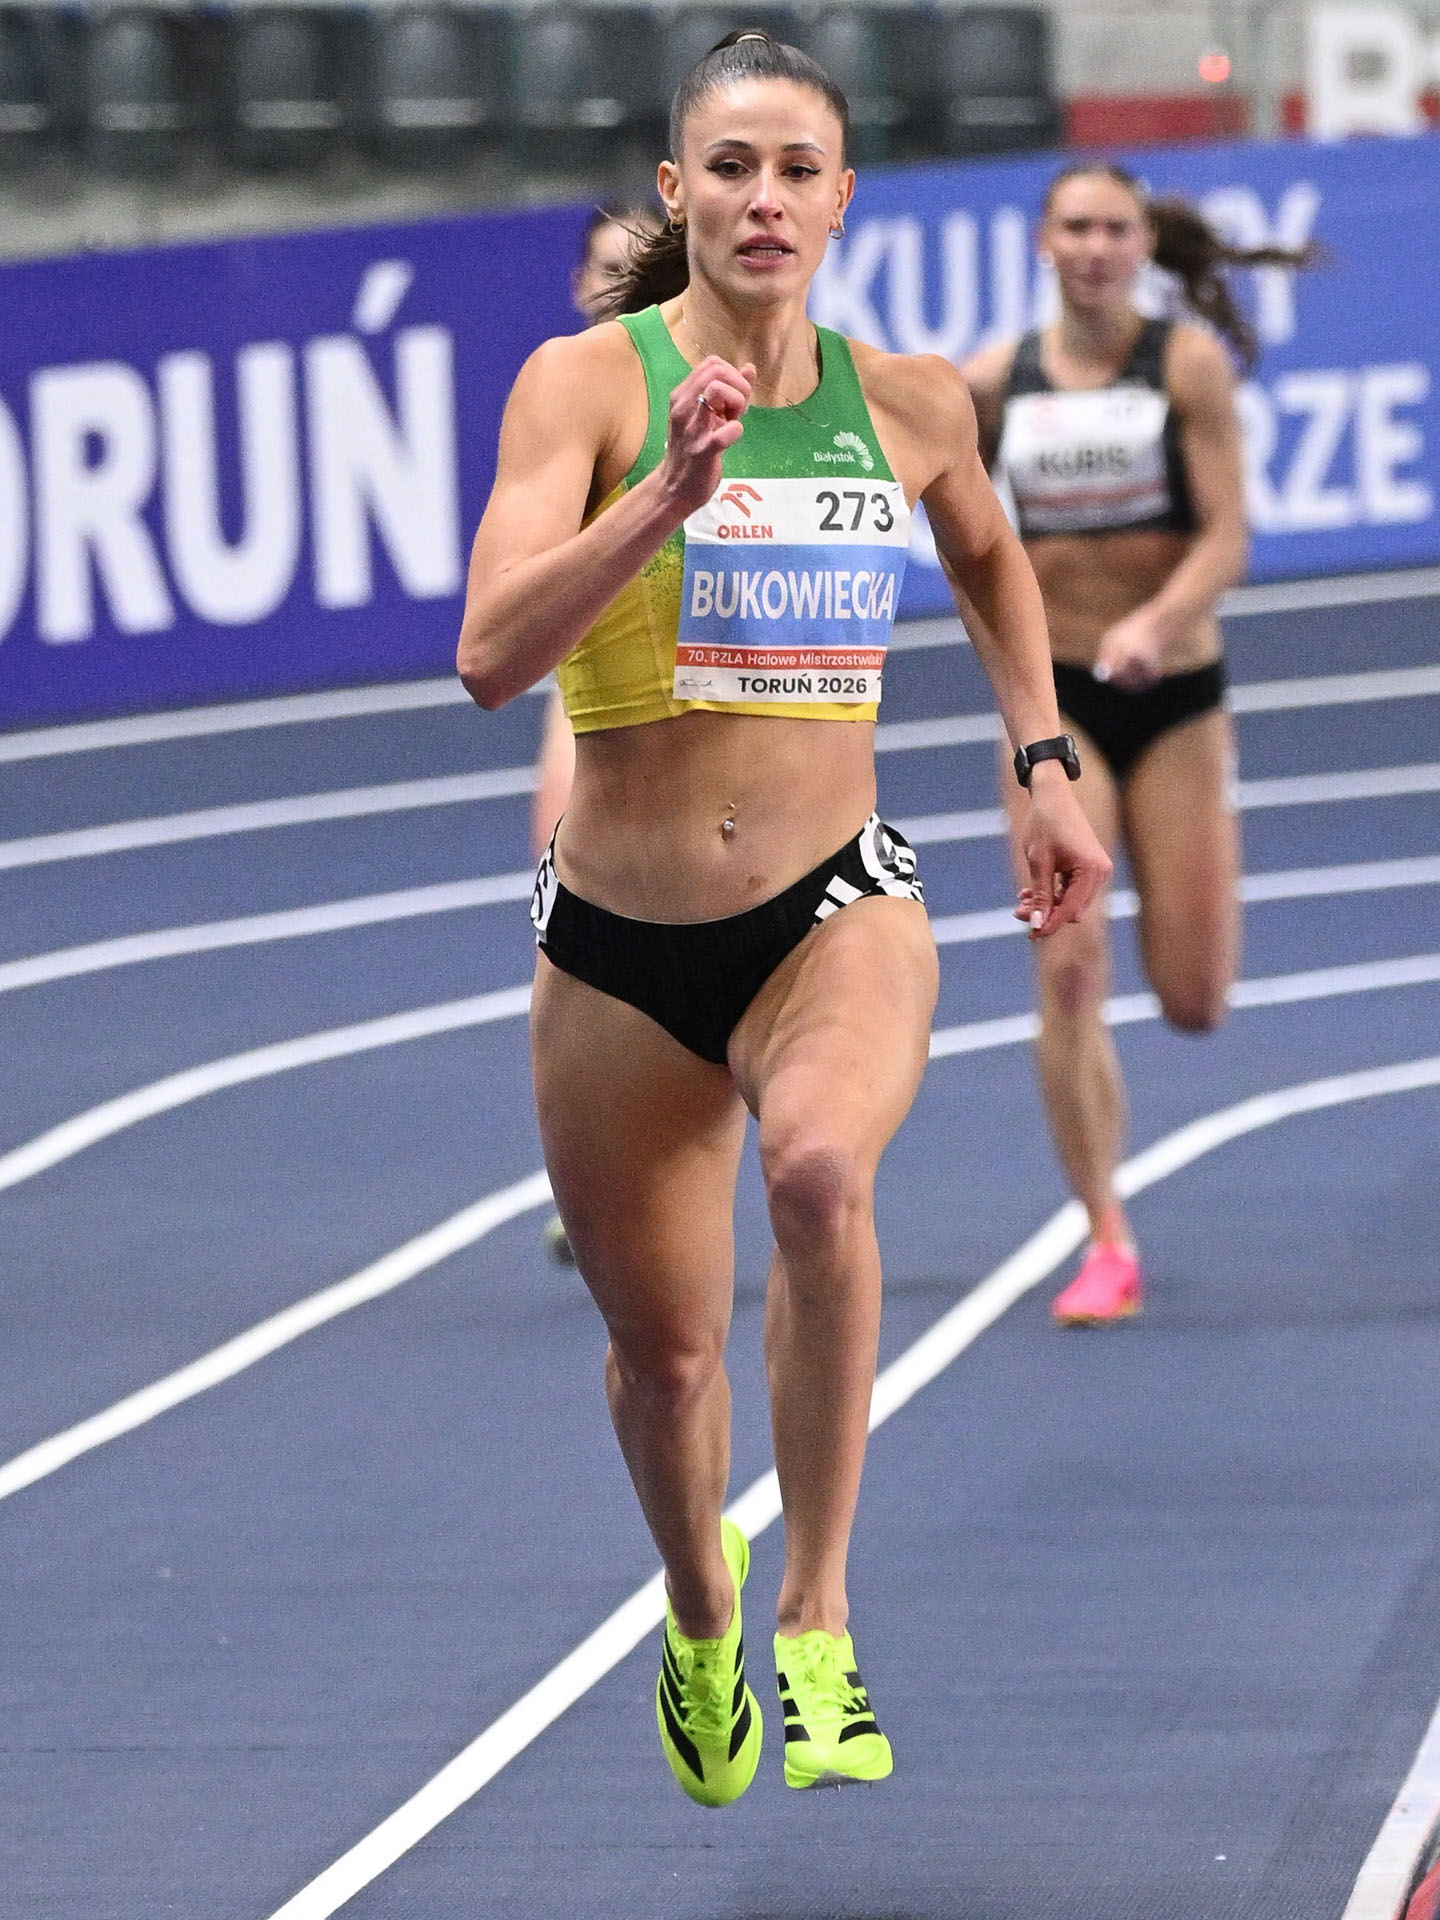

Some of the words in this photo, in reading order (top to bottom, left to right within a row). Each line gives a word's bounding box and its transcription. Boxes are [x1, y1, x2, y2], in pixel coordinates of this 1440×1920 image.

[0, 258, 461, 645] RUŃ
[815, 490, 894, 533] 273
[716, 525, 773, 539] ORLEN
[690, 570, 895, 621] BUKOWIECKA
[688, 650, 708, 663] 70.
[711, 651, 744, 665] PZLA
[747, 653, 797, 666] Halowe
[737, 673, 812, 694] TORUŃ
[817, 677, 867, 694] 2026
